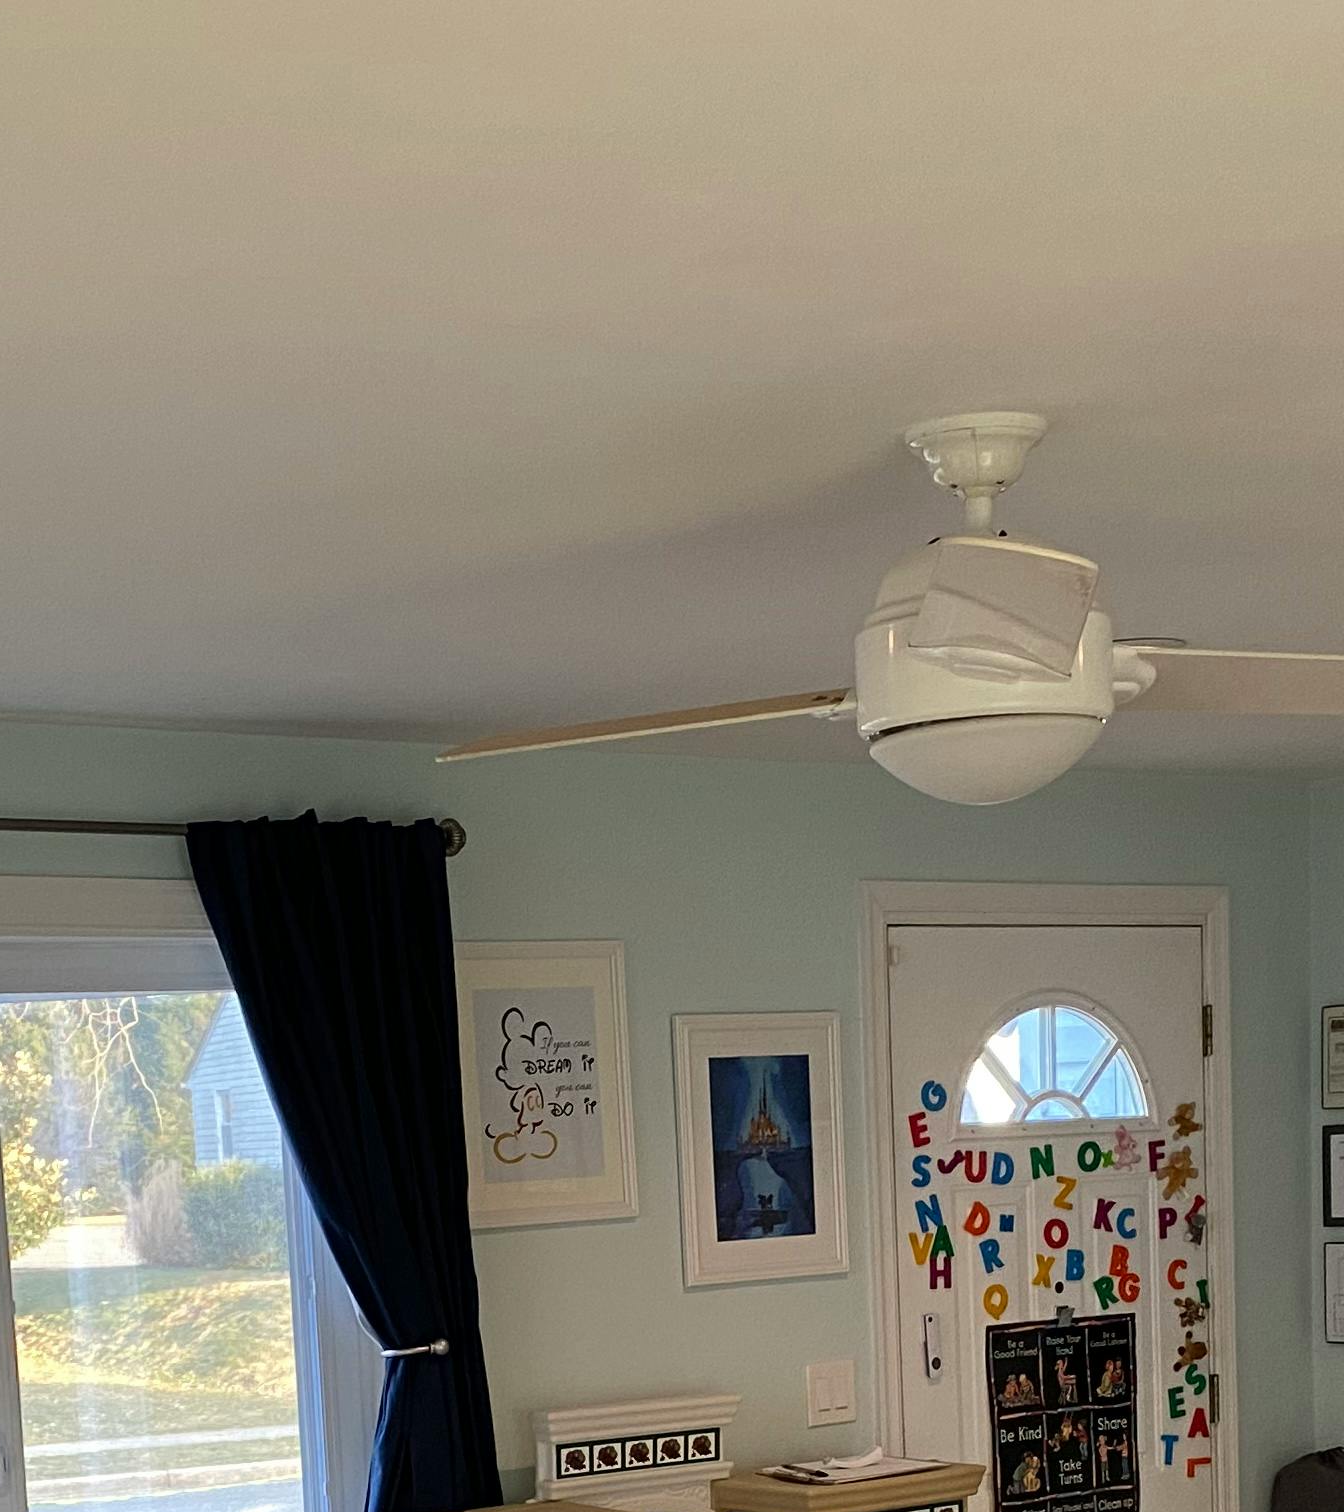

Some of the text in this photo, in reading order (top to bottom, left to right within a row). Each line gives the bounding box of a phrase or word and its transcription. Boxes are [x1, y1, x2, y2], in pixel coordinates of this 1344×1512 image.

[521, 1058, 572, 1075] DREAM
[548, 1101, 574, 1117] DO
[908, 1112, 931, 1148] E
[911, 1154, 932, 1188] S
[964, 1150, 987, 1183] U
[991, 1152, 1014, 1185] D
[1030, 1144, 1055, 1180] N
[1077, 1141, 1102, 1172] O
[1053, 1175, 1077, 1211] Z
[915, 1194, 943, 1233] N
[963, 1201, 990, 1236] D
[1093, 1198, 1117, 1233] K
[1116, 1207, 1137, 1239] C
[1158, 1207, 1178, 1239] P
[908, 1232, 934, 1266] V
[930, 1224, 955, 1258] A
[979, 1238, 1005, 1274] R
[929, 1256, 952, 1290] H
[1032, 1254, 1056, 1288] X
[1066, 1249, 1085, 1281] B
[1167, 1258, 1187, 1290] C
[983, 1283, 1009, 1321] Q
[1093, 1275, 1120, 1310] R
[1118, 1272, 1140, 1303] G
[994, 1347, 1038, 1359] Good Friend
[1185, 1363, 1206, 1396] S
[1168, 1386, 1186, 1419] E
[1000, 1426, 1042, 1443] Be Kind
[1097, 1417, 1128, 1431] Share
[1187, 1408, 1209, 1438] A
[1059, 1459, 1082, 1472] Take
[1161, 1435, 1179, 1466] T
[1058, 1473, 1083, 1486] Turns
[1098, 1500, 1122, 1511] Clean
